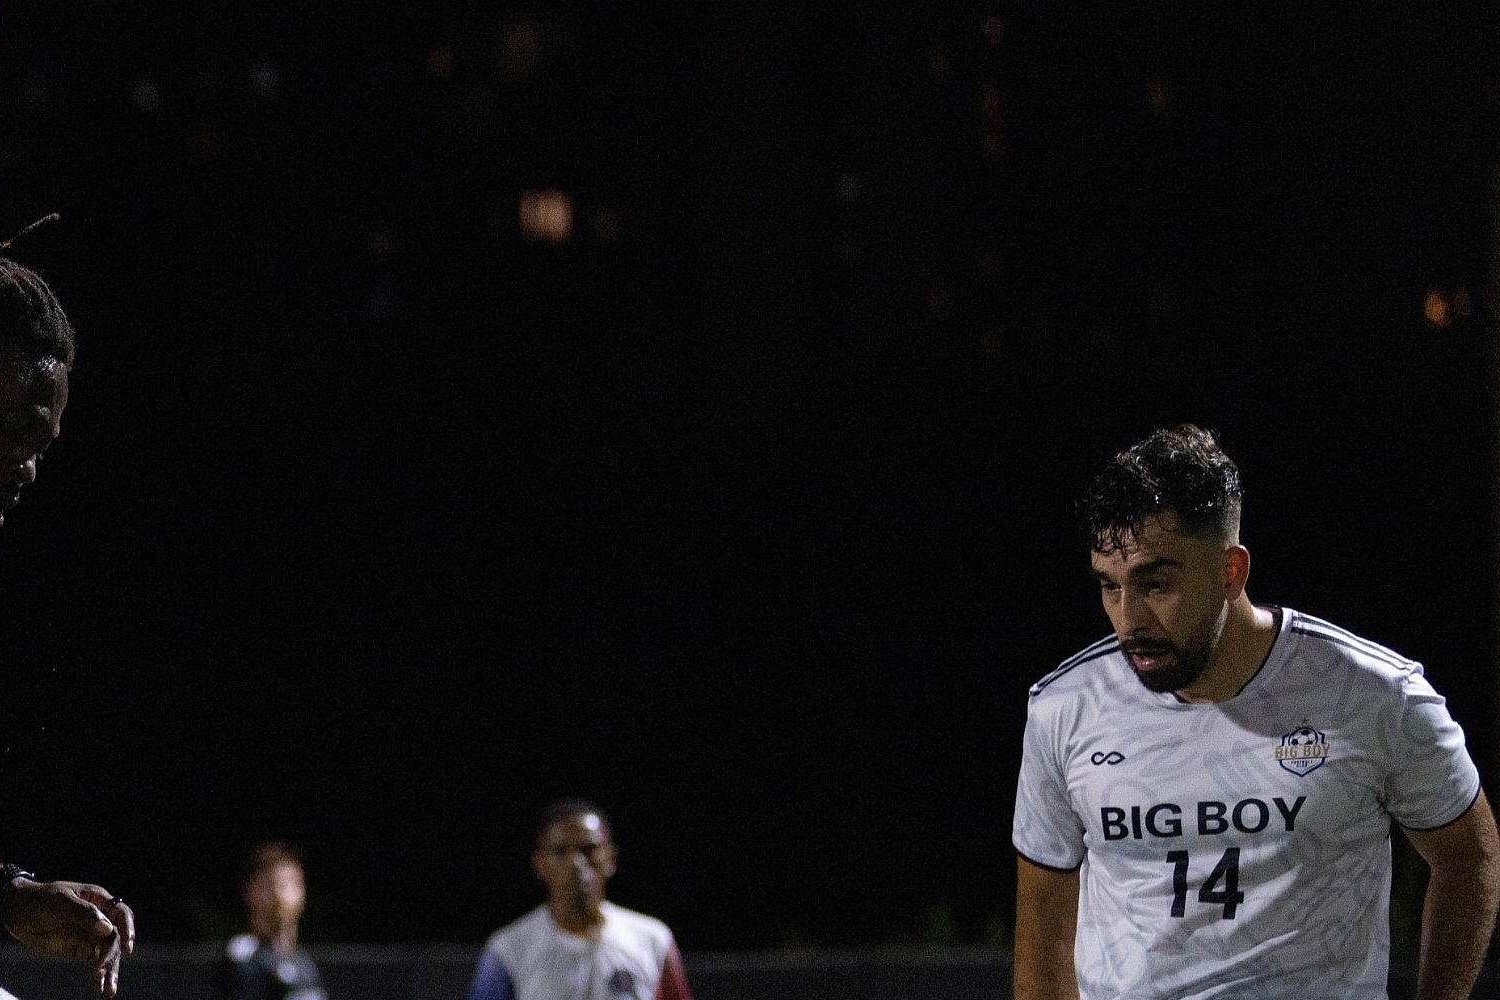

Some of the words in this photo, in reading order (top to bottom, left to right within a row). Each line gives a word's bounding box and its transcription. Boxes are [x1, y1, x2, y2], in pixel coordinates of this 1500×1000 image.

[1275, 746, 1297, 759] BIG
[1303, 743, 1330, 757] BOY
[1100, 803, 1183, 841] BIG
[1197, 796, 1307, 836] BOY
[1166, 847, 1244, 919] 14
